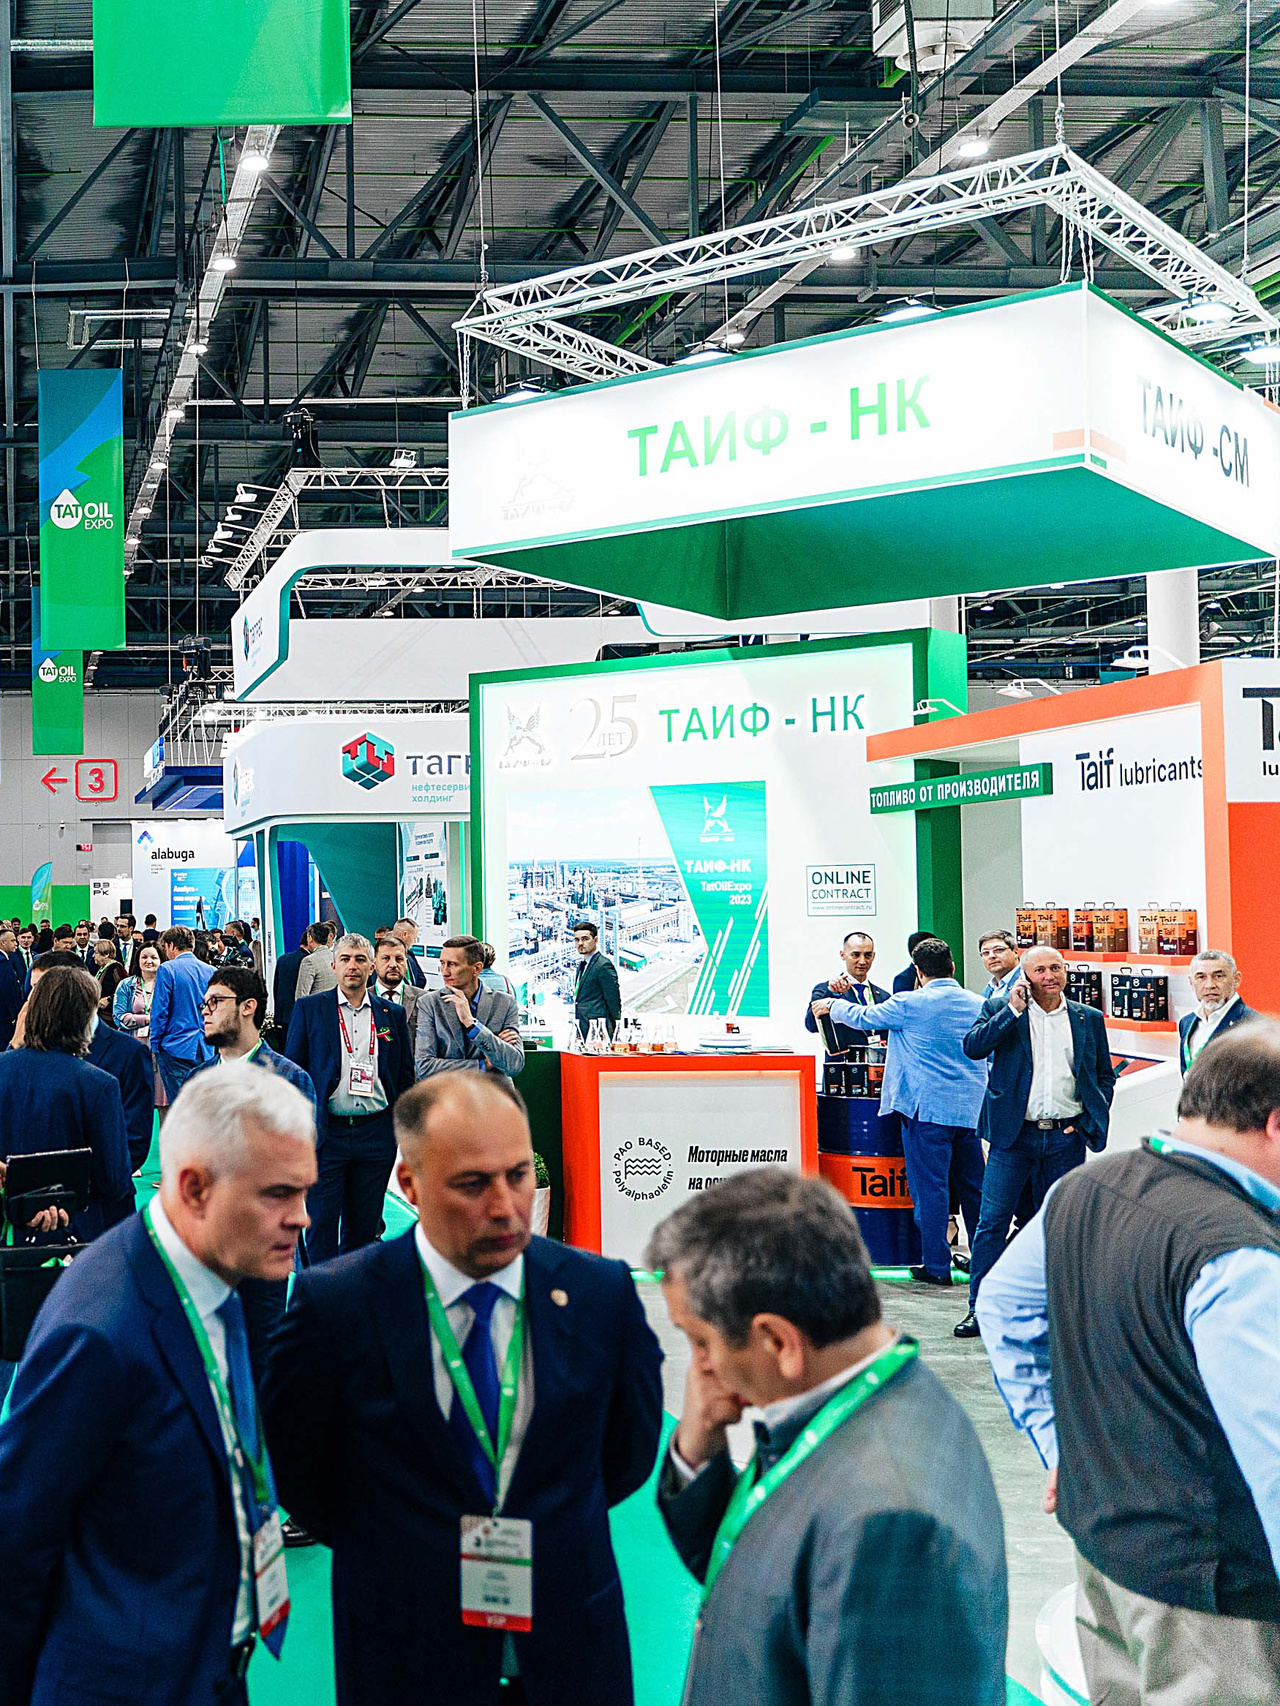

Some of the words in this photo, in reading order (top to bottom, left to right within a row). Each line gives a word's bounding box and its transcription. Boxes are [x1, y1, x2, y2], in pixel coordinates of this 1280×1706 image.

[627, 405, 789, 476] ТАИФ
[850, 374, 931, 440] НК
[1137, 374, 1203, 460] ТАИФ
[54, 504, 81, 519] TAT
[84, 502, 113, 518] OIL
[84, 519, 114, 530] EXPO
[41, 667, 57, 676] TAT
[59, 666, 76, 676] OIL
[659, 702, 771, 742] ТАИФ
[811, 693, 865, 732] НК
[569, 694, 639, 760] 25
[596, 731, 626, 748] ЛЕТ
[1075, 748, 1114, 791] Taif
[1119, 756, 1203, 787] lubricants
[88, 768, 105, 793] 3
[870, 790, 916, 808] ТОПЛИВО
[919, 785, 933, 802] ОТ
[937, 770, 1040, 800] ПРОИЗВОДИТЕЛЯ
[411, 795, 454, 804] холдинг
[151, 847, 195, 862] alabuga
[684, 858, 751, 874] ТАИФ-НК
[811, 870, 871, 885] ONLINE
[700, 881, 752, 893] TatOilExpo
[811, 888, 871, 900] CONTRACT
[729, 894, 752, 905] 2023
[613, 1141, 633, 1161] PAO
[638, 1137, 671, 1161] BASED
[688, 1146, 748, 1166] Моторные
[750, 1149, 788, 1162] масла
[688, 1177, 703, 1190] на
[852, 1166, 907, 1197] Taif
